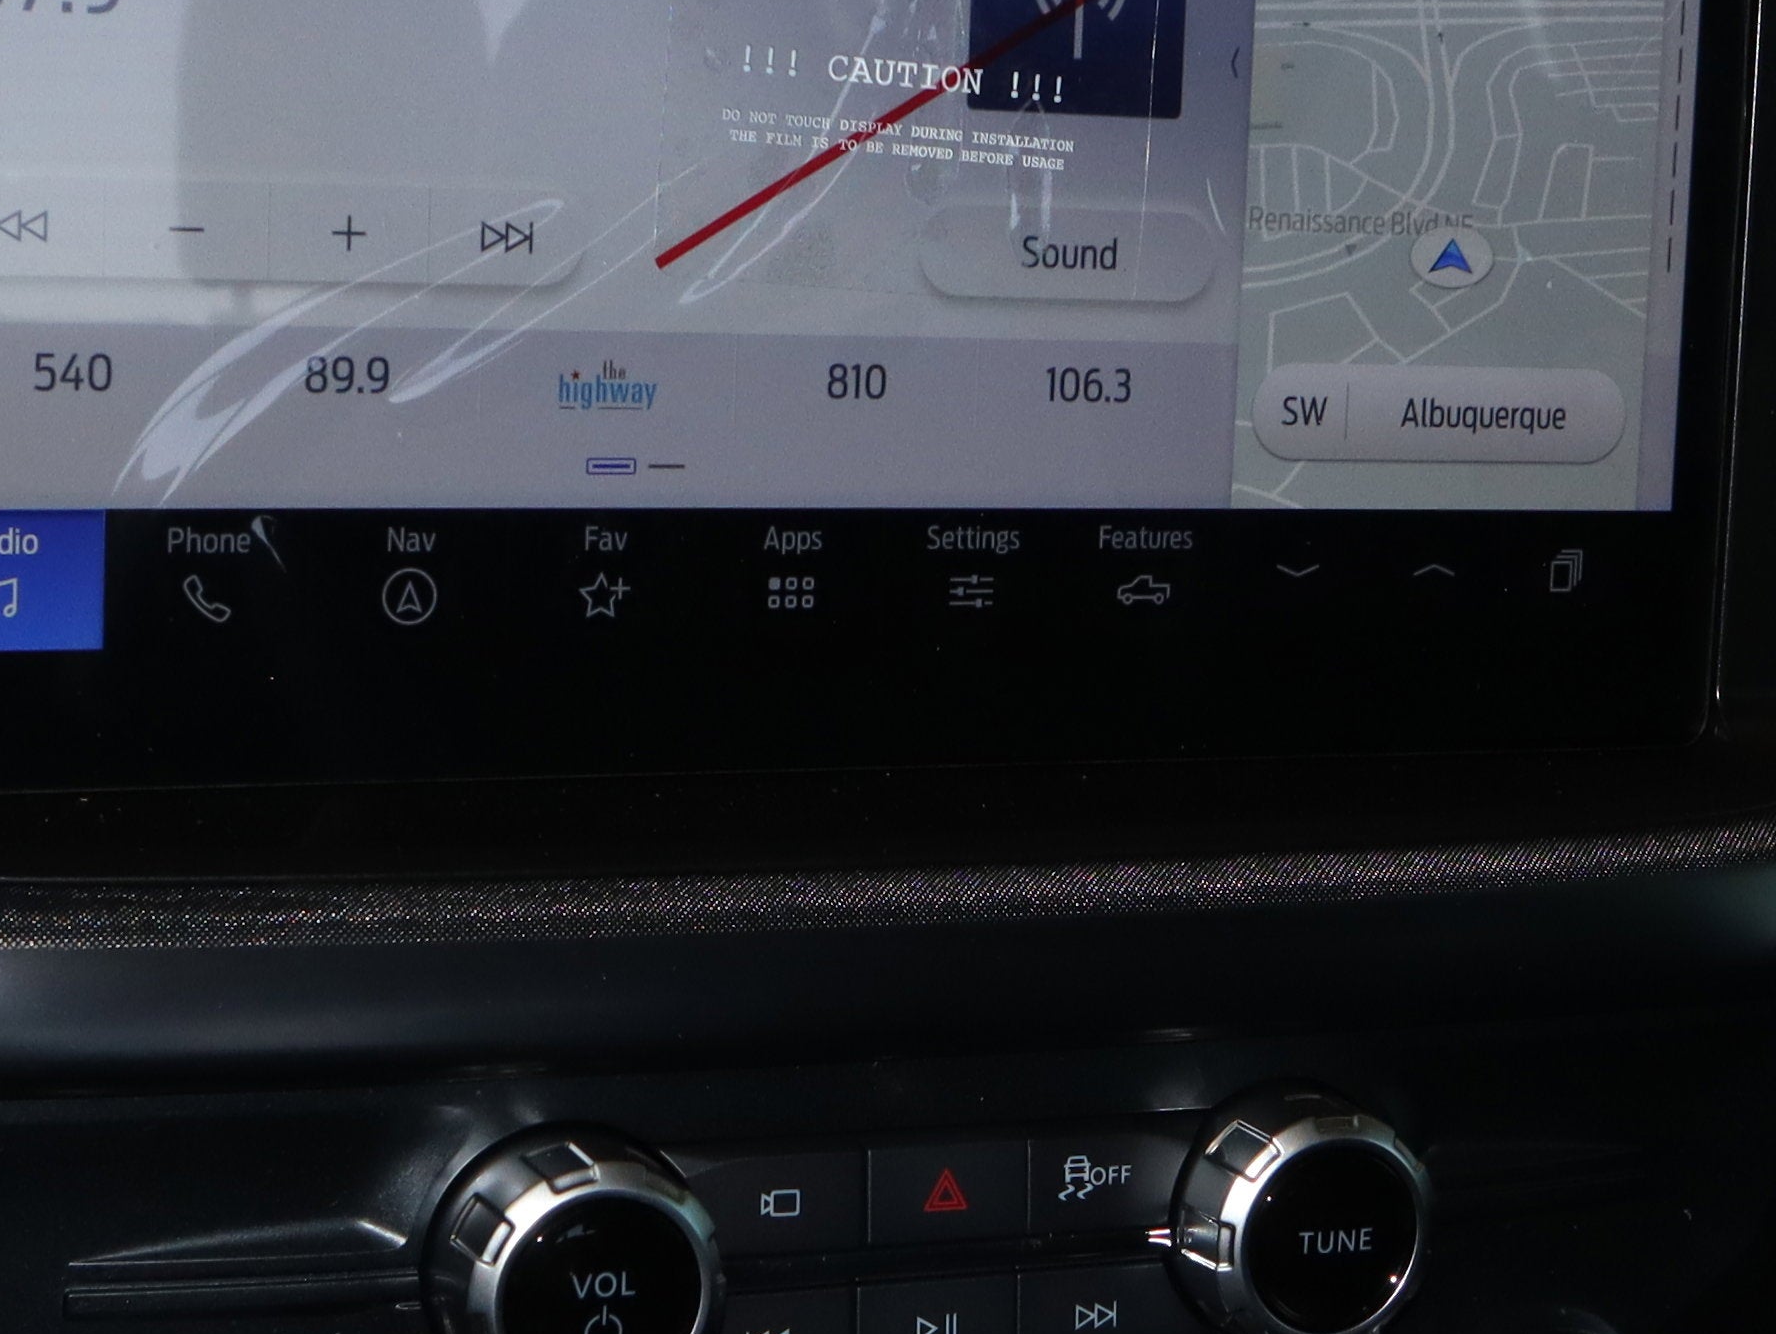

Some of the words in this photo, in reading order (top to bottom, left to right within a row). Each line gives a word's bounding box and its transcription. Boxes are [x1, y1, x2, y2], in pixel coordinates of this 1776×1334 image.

[827, 54, 984, 96] CAUTION
[722, 108, 742, 122] DO
[749, 111, 779, 126] NOT
[785, 114, 831, 131] TOUCH
[839, 118, 903, 137] DISPLAY
[911, 125, 964, 143] DURING
[972, 131, 1075, 153] INSTALLATION
[729, 128, 756, 143] THE
[765, 132, 802, 147] FILM
[811, 136, 829, 150] IS
[837, 138, 858, 152] TO
[866, 140, 884, 155] BE
[892, 142, 954, 161] REMOVED
[961, 149, 1014, 167] BEFORE
[1022, 155, 1065, 171] USAGE
[1248, 205, 1386, 235] Renaissance
[1391, 211, 1438, 236] Blvd
[1021, 235, 1119, 271] Sound
[33, 352, 114, 394] 540
[304, 354, 390, 395] 89.9
[602, 360, 627, 381] the
[826, 364, 887, 401] 810
[1046, 367, 1132, 404] 106.3
[558, 371, 658, 411] highway
[1281, 395, 1328, 427] SW
[1400, 397, 1567, 439] Albuquerque
[167, 527, 252, 555] Phone
[386, 527, 437, 553] Nav
[584, 526, 628, 552] Fav
[764, 526, 823, 559] Apps
[927, 524, 1021, 555] Settings
[1098, 525, 1193, 552] Features
[1091, 1165, 1132, 1185] OFF
[1299, 1227, 1374, 1255] TUNE
[571, 1271, 636, 1300] VOL
